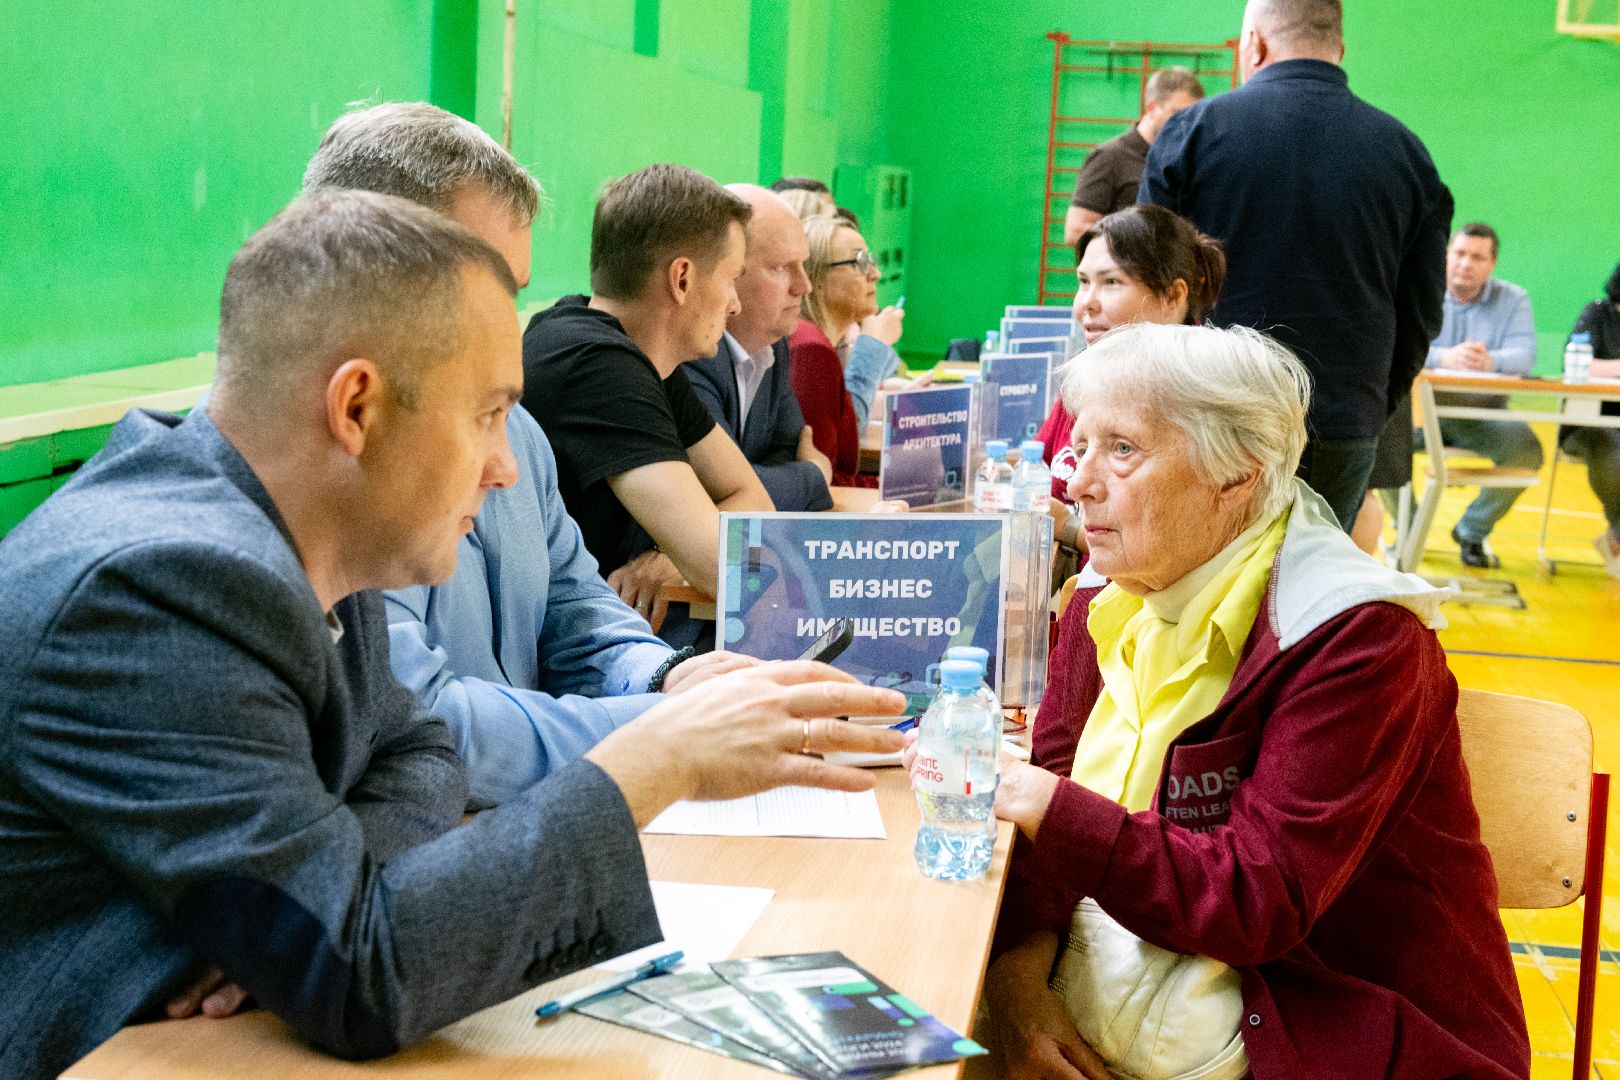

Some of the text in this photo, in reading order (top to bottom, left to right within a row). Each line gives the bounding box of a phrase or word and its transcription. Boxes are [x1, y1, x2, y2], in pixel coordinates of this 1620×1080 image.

[899, 410, 968, 429] СТРОИТЕЛЬСТВО
[903, 433, 961, 450] АРХИТЕКТУРА
[804, 540, 960, 560] ТРАНСПОРТ
[829, 579, 933, 599] БИЗНЕС
[796, 617, 961, 639] ИМЩЕСТВО
